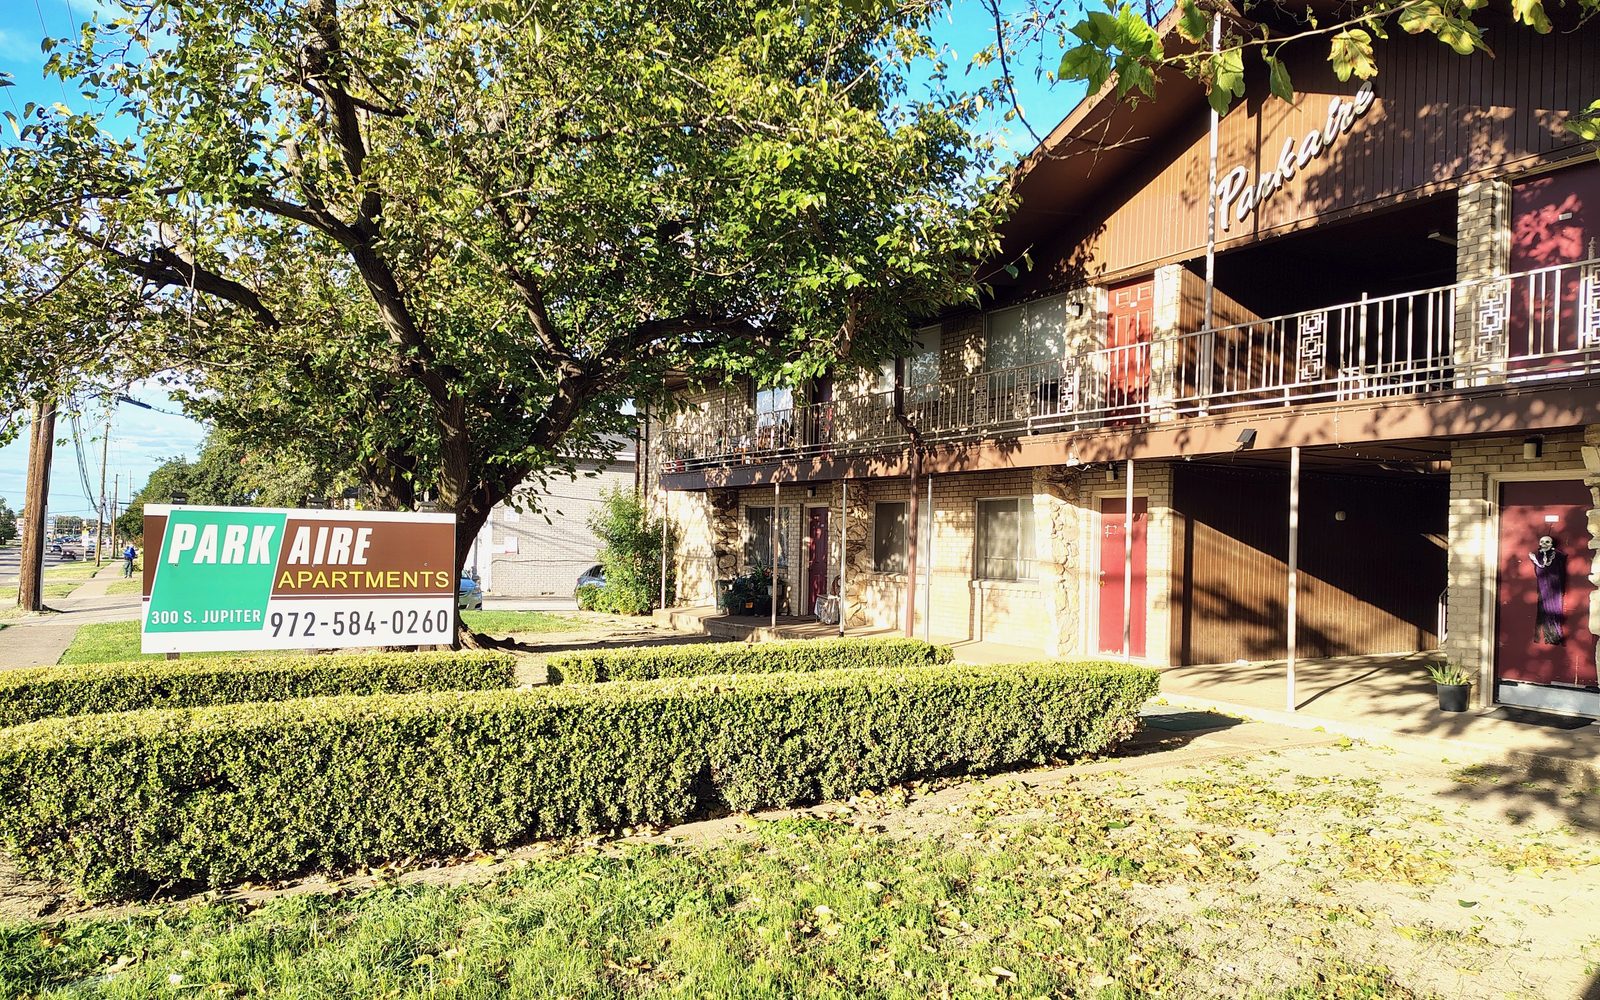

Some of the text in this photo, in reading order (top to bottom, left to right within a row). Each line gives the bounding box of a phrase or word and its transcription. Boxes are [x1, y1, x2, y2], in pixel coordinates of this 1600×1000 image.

[1217, 81, 1375, 230] Parkaire
[167, 523, 373, 565] PARK AIRE
[277, 571, 449, 589] APARTMENTS
[151, 609, 261, 625] 300 S. JUPITER
[270, 609, 448, 638] 972-584-0260
